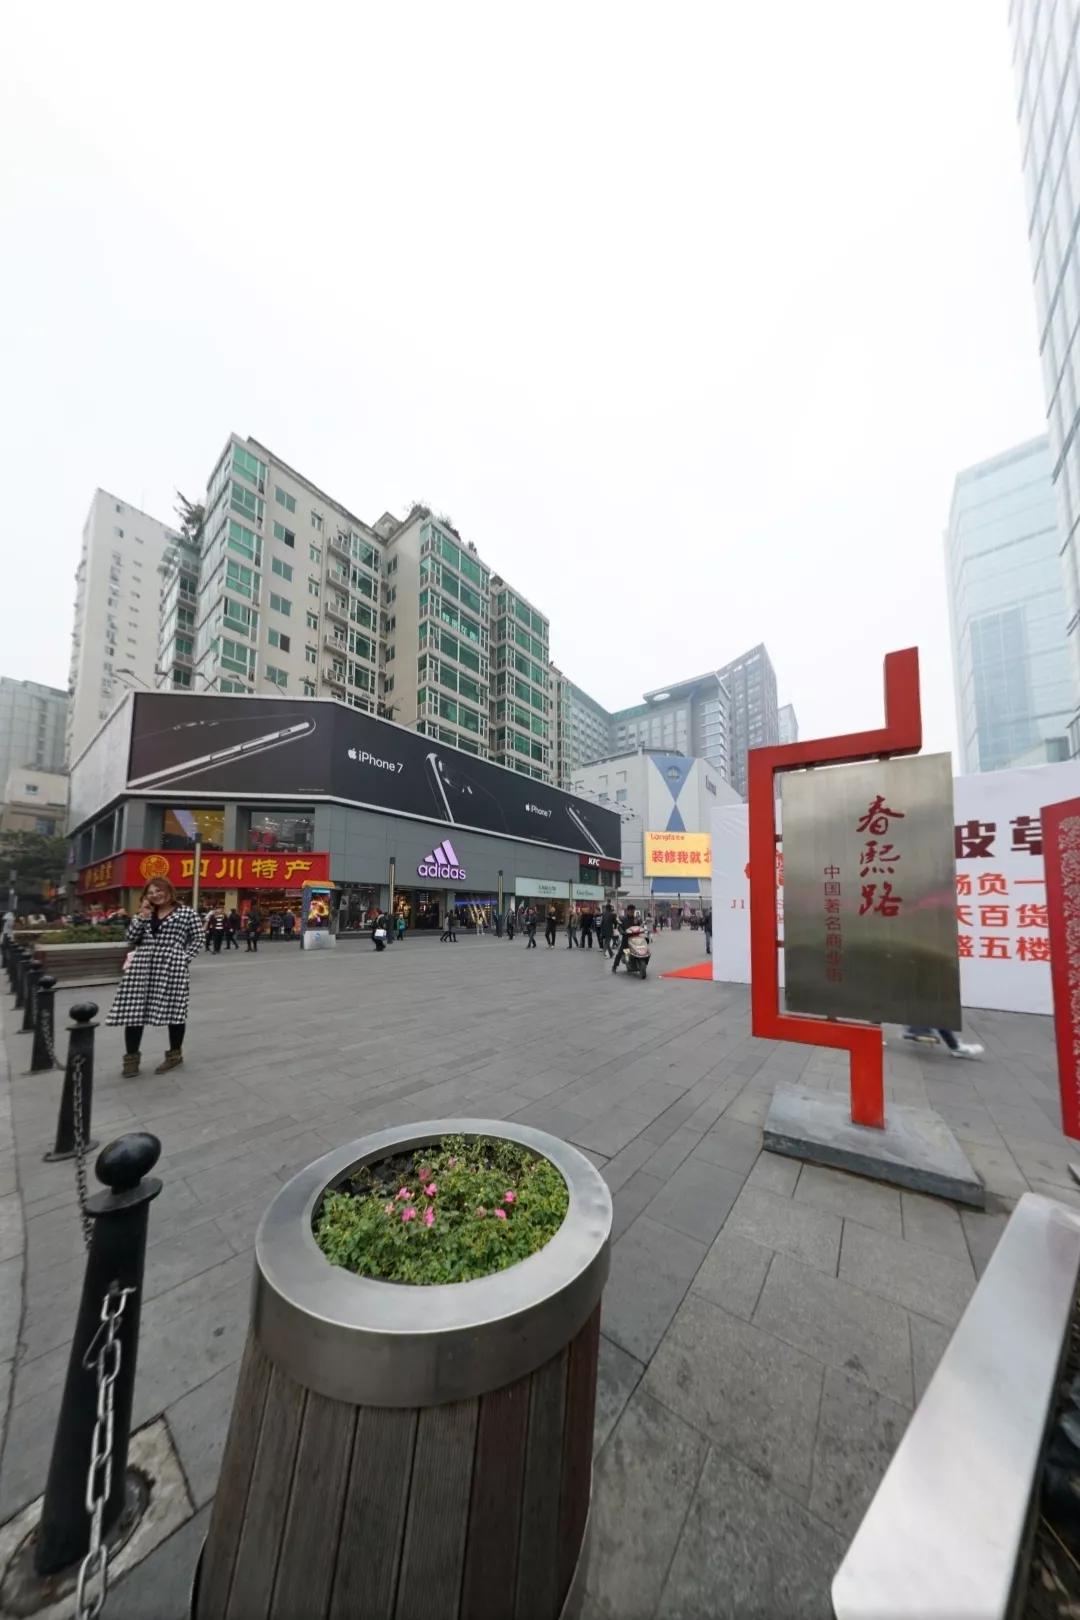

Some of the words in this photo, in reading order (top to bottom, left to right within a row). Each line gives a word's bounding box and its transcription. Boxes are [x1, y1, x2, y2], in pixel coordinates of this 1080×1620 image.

[358, 750, 396, 772] iPhone
[396, 761, 404, 774] 7
[530, 804, 549, 817] iPhone
[588, 856, 600, 867] KFC
[856, 794, 905, 917] 春熙路
[181, 857, 313, 880] 四川特产
[417, 862, 466, 881] adidas
